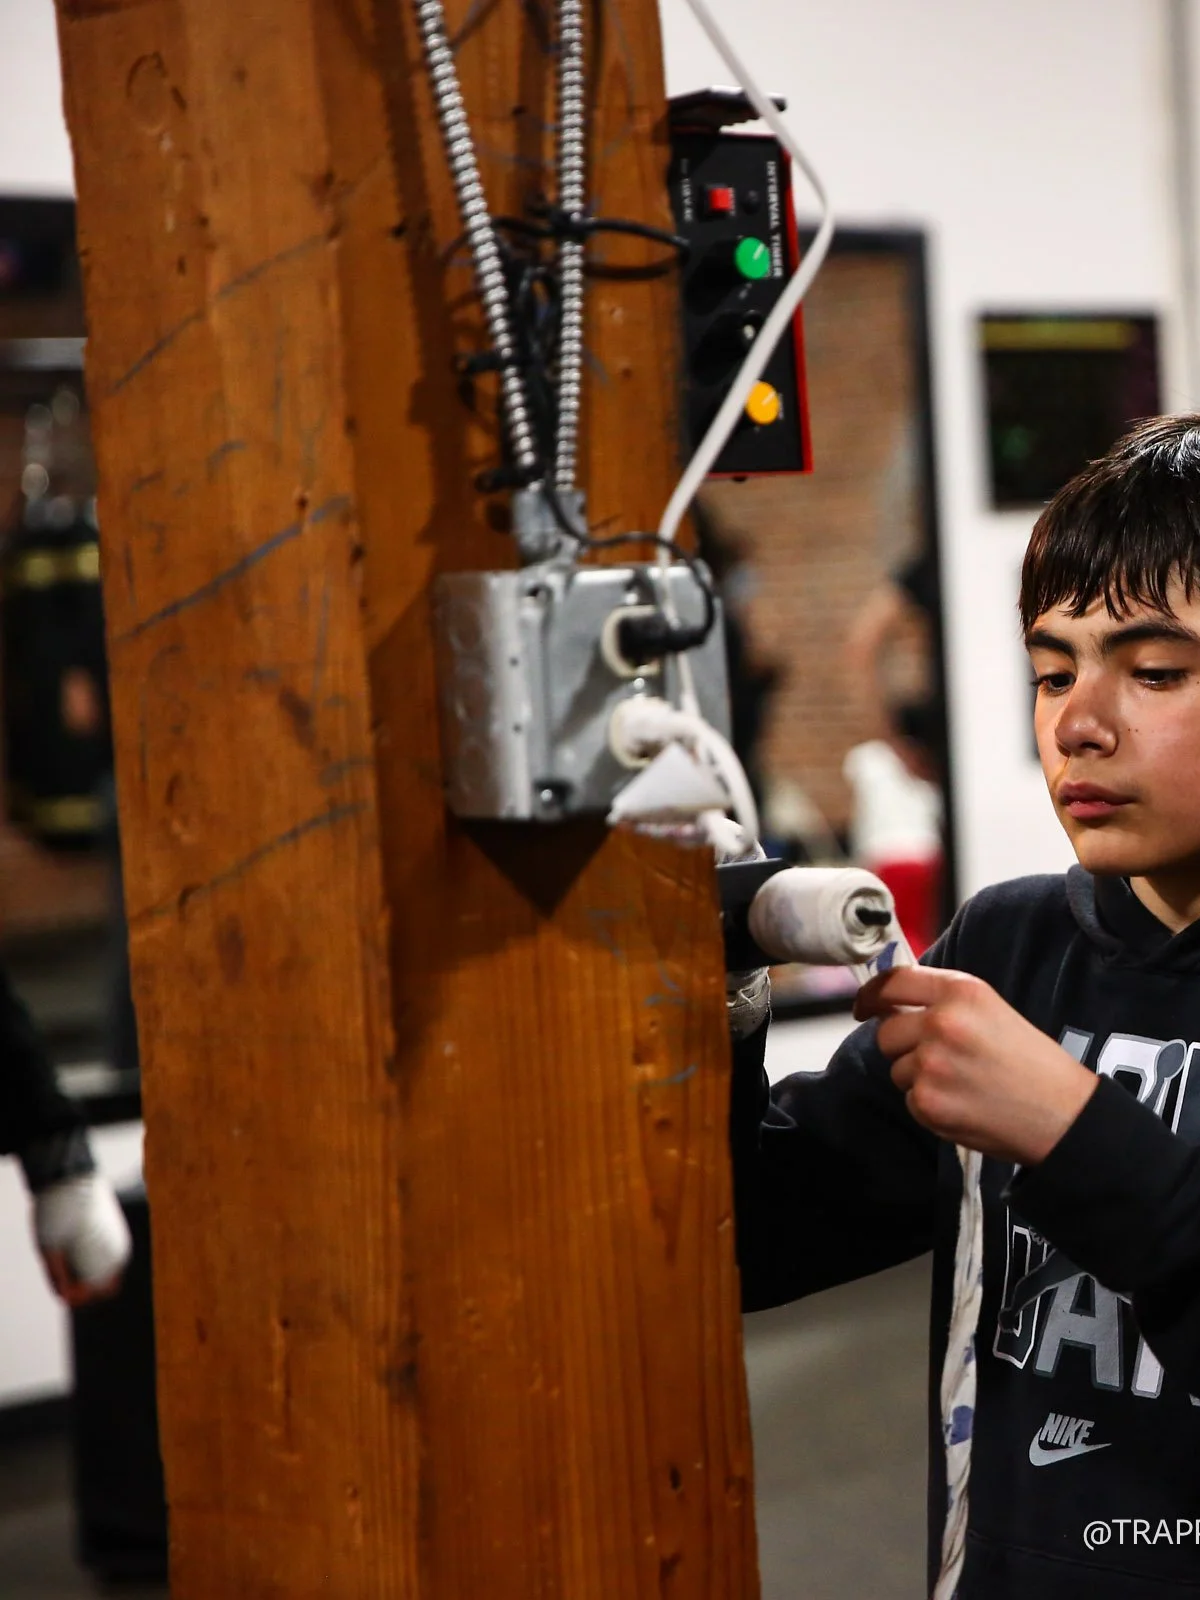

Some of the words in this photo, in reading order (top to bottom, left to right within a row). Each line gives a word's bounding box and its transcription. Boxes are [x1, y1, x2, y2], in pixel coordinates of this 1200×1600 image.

[766, 160, 781, 230] INTERVAL
[770, 233, 785, 278] TIMER
[1039, 1411, 1096, 1447] NIKE
